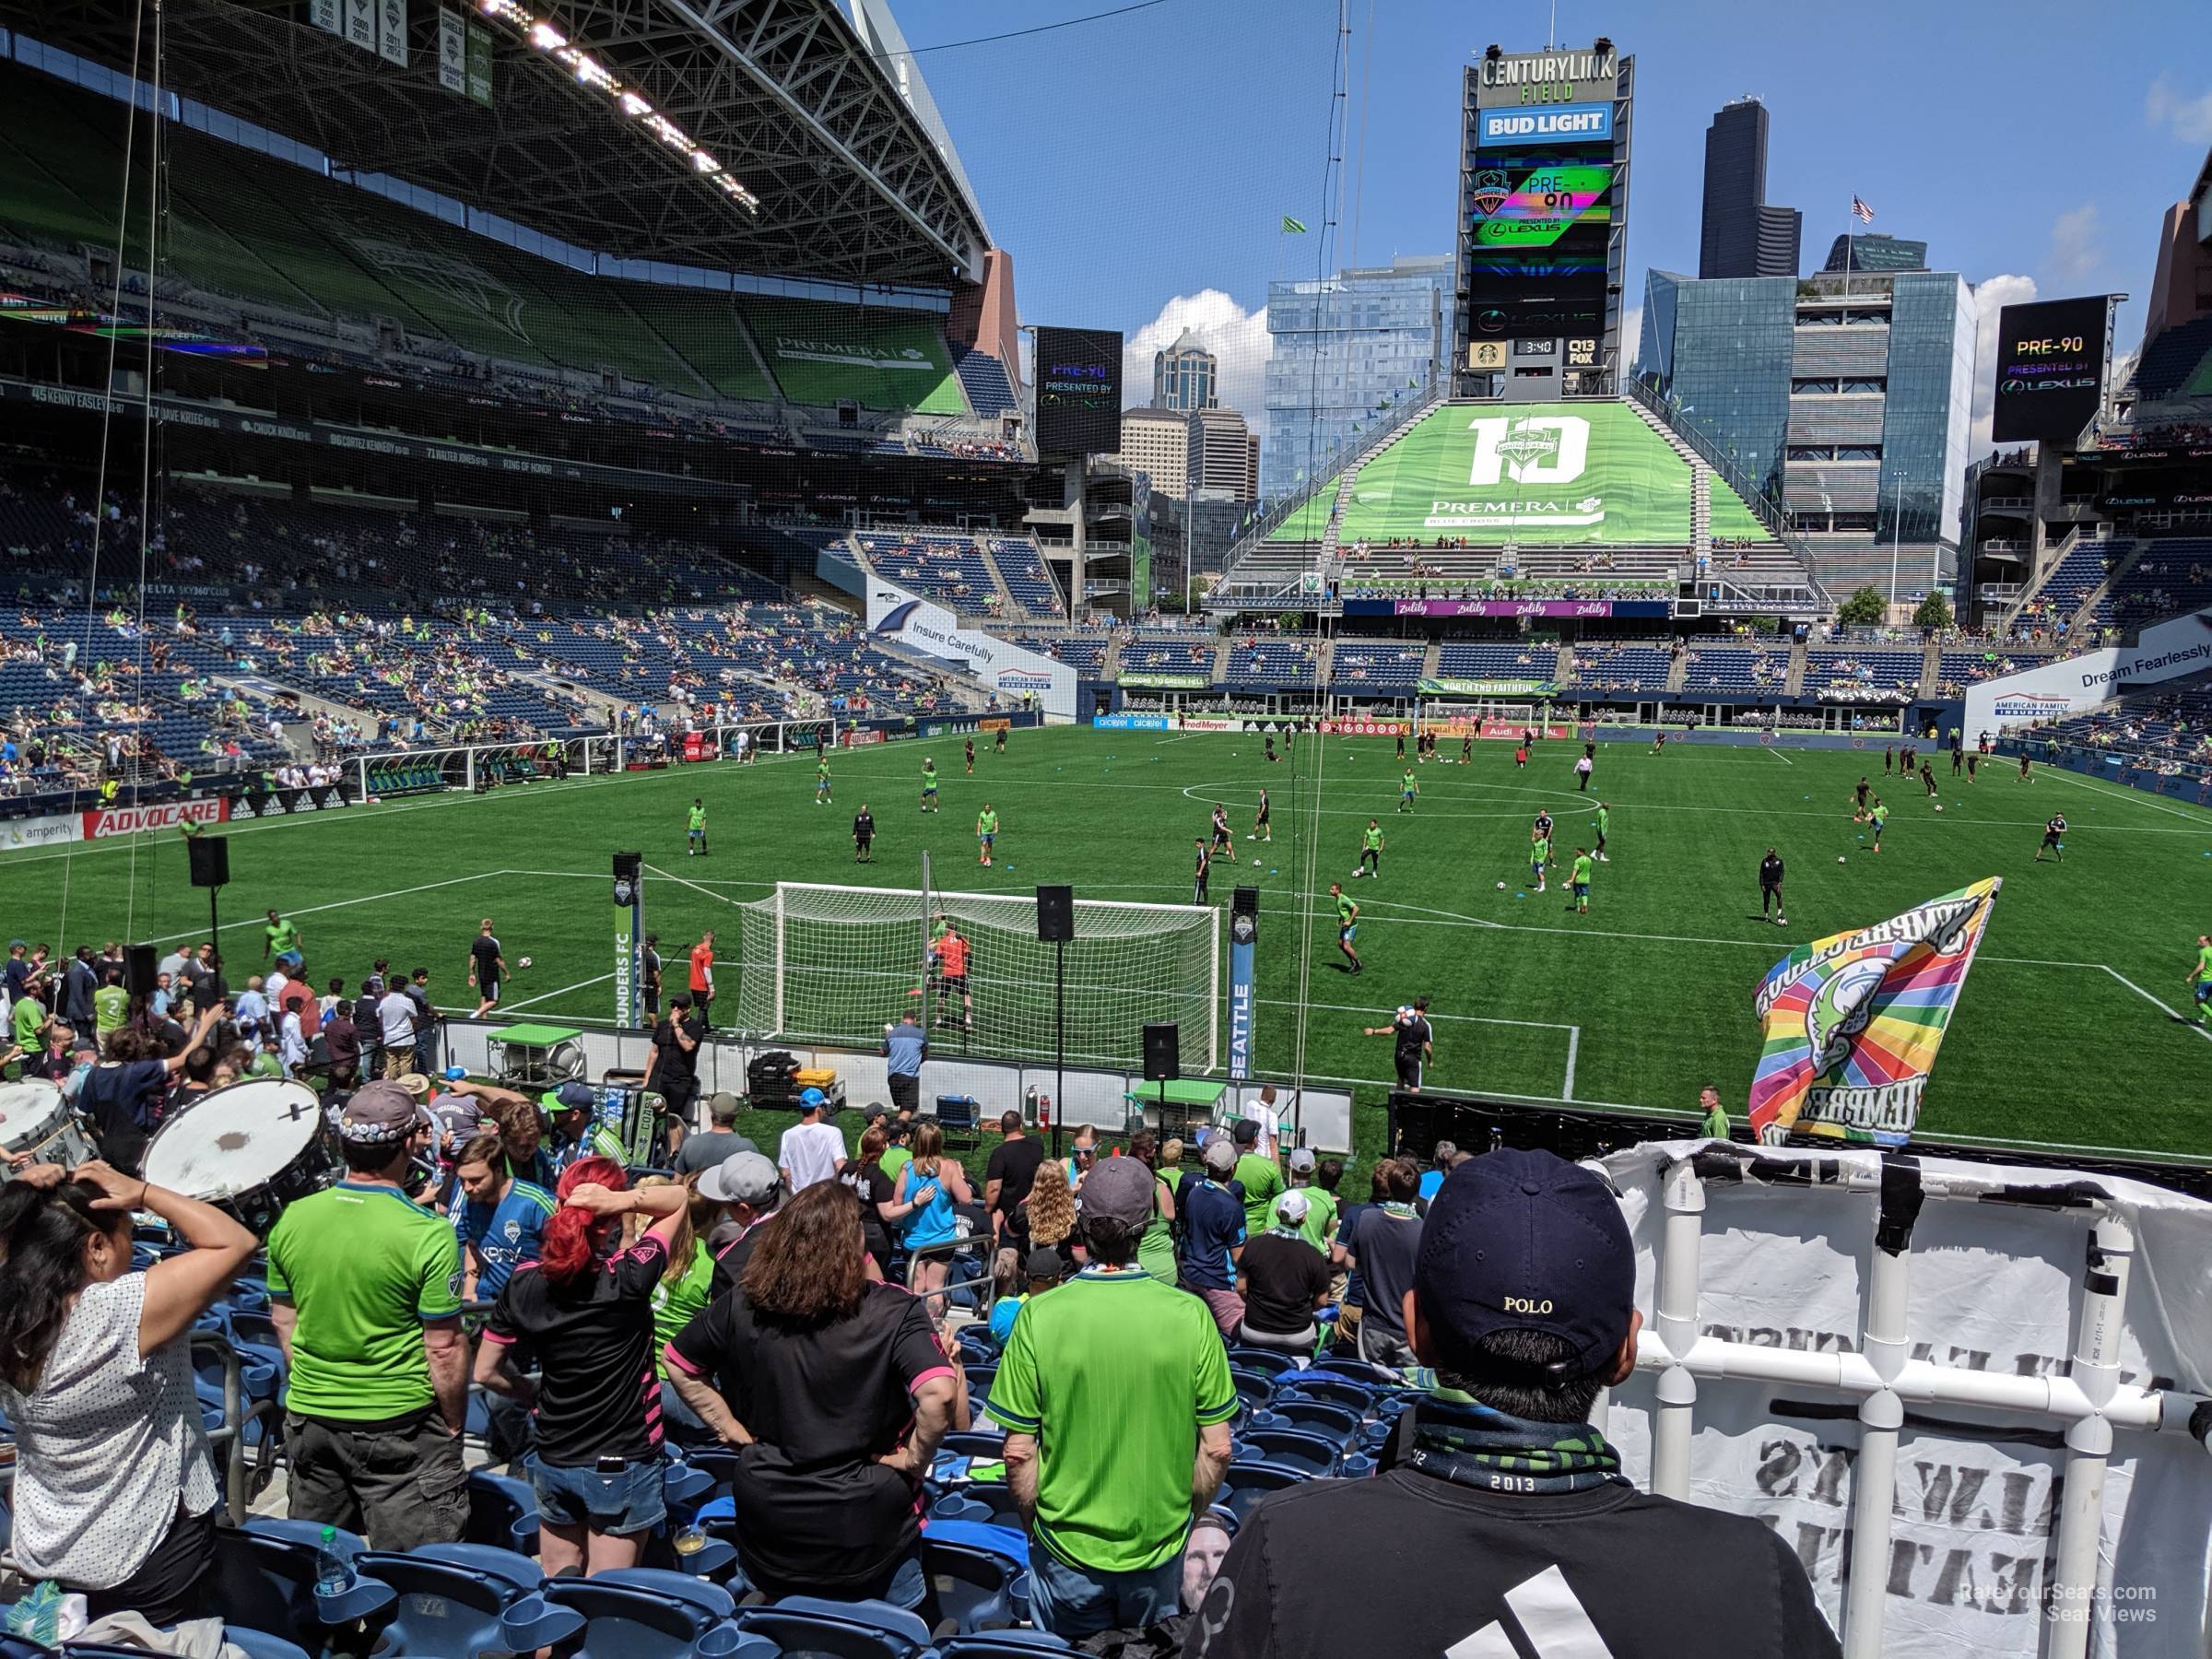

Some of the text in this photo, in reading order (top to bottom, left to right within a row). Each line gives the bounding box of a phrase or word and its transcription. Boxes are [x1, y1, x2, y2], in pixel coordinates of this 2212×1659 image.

[353, 17, 369, 31] 2009
[441, 18, 464, 37] SHIELD
[387, 32, 401, 46] 2011
[1483, 54, 1614, 86] CENTURYLINK
[1522, 84, 1573, 103] FIELD
[1488, 113, 1603, 135] BUD LIGHT
[1509, 223, 1561, 233] LEXUS
[776, 336, 889, 359] PREMERA
[1526, 342, 1551, 353] 3:40
[1569, 339, 1596, 354] Q13
[2017, 336, 2084, 356] PRE-90
[1570, 353, 1594, 365] FOX
[2007, 361, 2071, 376] PRESENTED
[1045, 382, 1112, 394] PRESENTED BY
[2028, 378, 2097, 392] LEXUS
[31, 388, 47, 401] 45
[47, 391, 76, 406] KENNY
[77, 395, 107, 411] EASLEY
[179, 411, 203, 425] KRIEG
[253, 422, 276, 436] CHUCK
[277, 426, 297, 441] KNOX
[330, 433, 343, 446] 96
[343, 436, 365, 450] CORTEZ
[367, 439, 394, 453] KENNEDY
[435, 449, 458, 461] WALTER
[2134, 451, 2168, 459] LEXUS
[503, 459, 553, 475] RING OF HONOR
[1430, 501, 1559, 514] PREMERA
[139, 583, 175, 595] DELTA
[210, 586, 230, 597] CLUB
[1400, 601, 1428, 616] zulily
[1457, 602, 1487, 616] zulily
[1516, 603, 1546, 616] zulily
[1577, 602, 1607, 616] zulily
[912, 621, 995, 664] Insure Carefully
[2082, 642, 2211, 688] Dream Fearlessly
[998, 675, 1053, 685] AMERICAN FAMILY
[1443, 682, 1534, 692] NORTH END FAITHFUL
[1818, 689, 1913, 704] DRINK SING SUPPORT
[1995, 700, 2070, 710] AMERICAN FAMILY
[1134, 719, 1162, 727] alcatel
[1489, 727, 1512, 735] Audi
[262, 806, 286, 817] adidas
[295, 804, 317, 812] adidas
[323, 800, 345, 809] adidas
[98, 801, 218, 831] ADVOCARE
[230, 810, 256, 820] adidas
[26, 823, 73, 840] amperity
[618, 933, 629, 953] FC
[109, 999, 119, 1014] 2
[1231, 983, 1248, 1079] SEATTLE
[445, 1117, 453, 1130] 1
[1504, 1297, 1553, 1314] POLO
[1491, 1475, 1535, 1491] 2013
